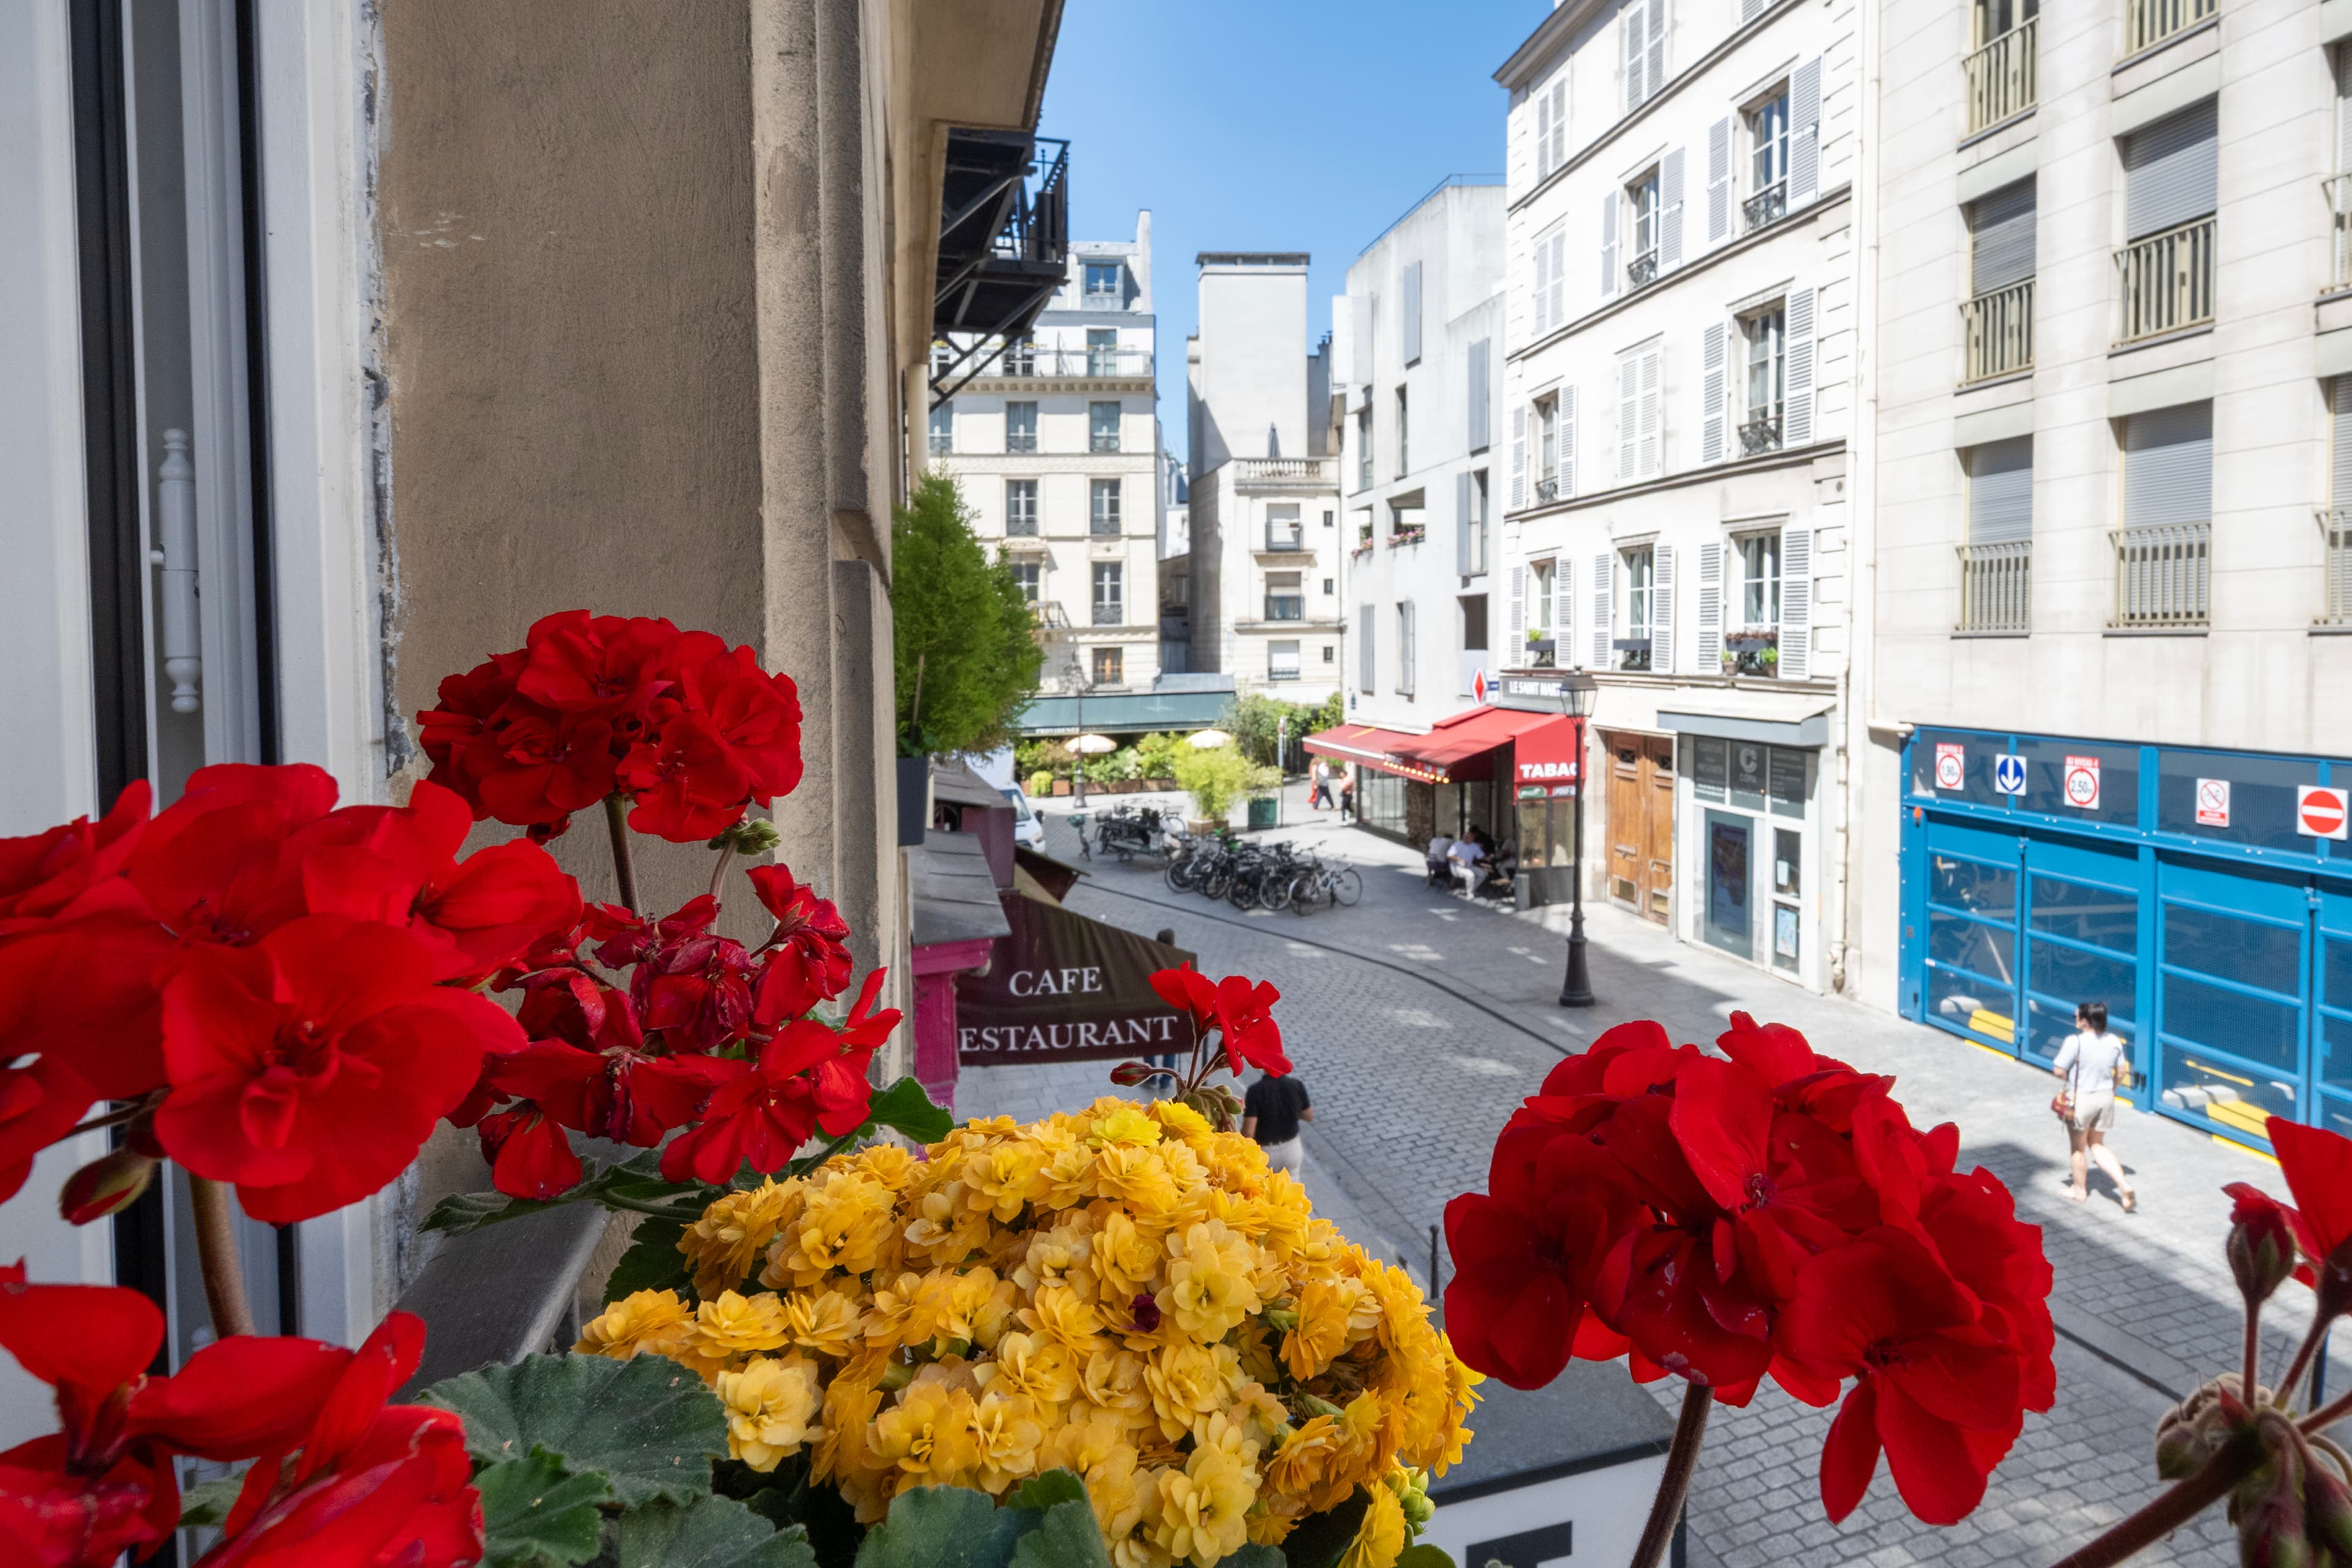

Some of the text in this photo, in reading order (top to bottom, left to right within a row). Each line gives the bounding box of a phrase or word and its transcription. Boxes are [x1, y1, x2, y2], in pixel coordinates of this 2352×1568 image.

[1520, 762, 1577, 778] TABAC
[1009, 967, 1102, 997] CAFE
[959, 1016, 1178, 1052] ESTAURANT
